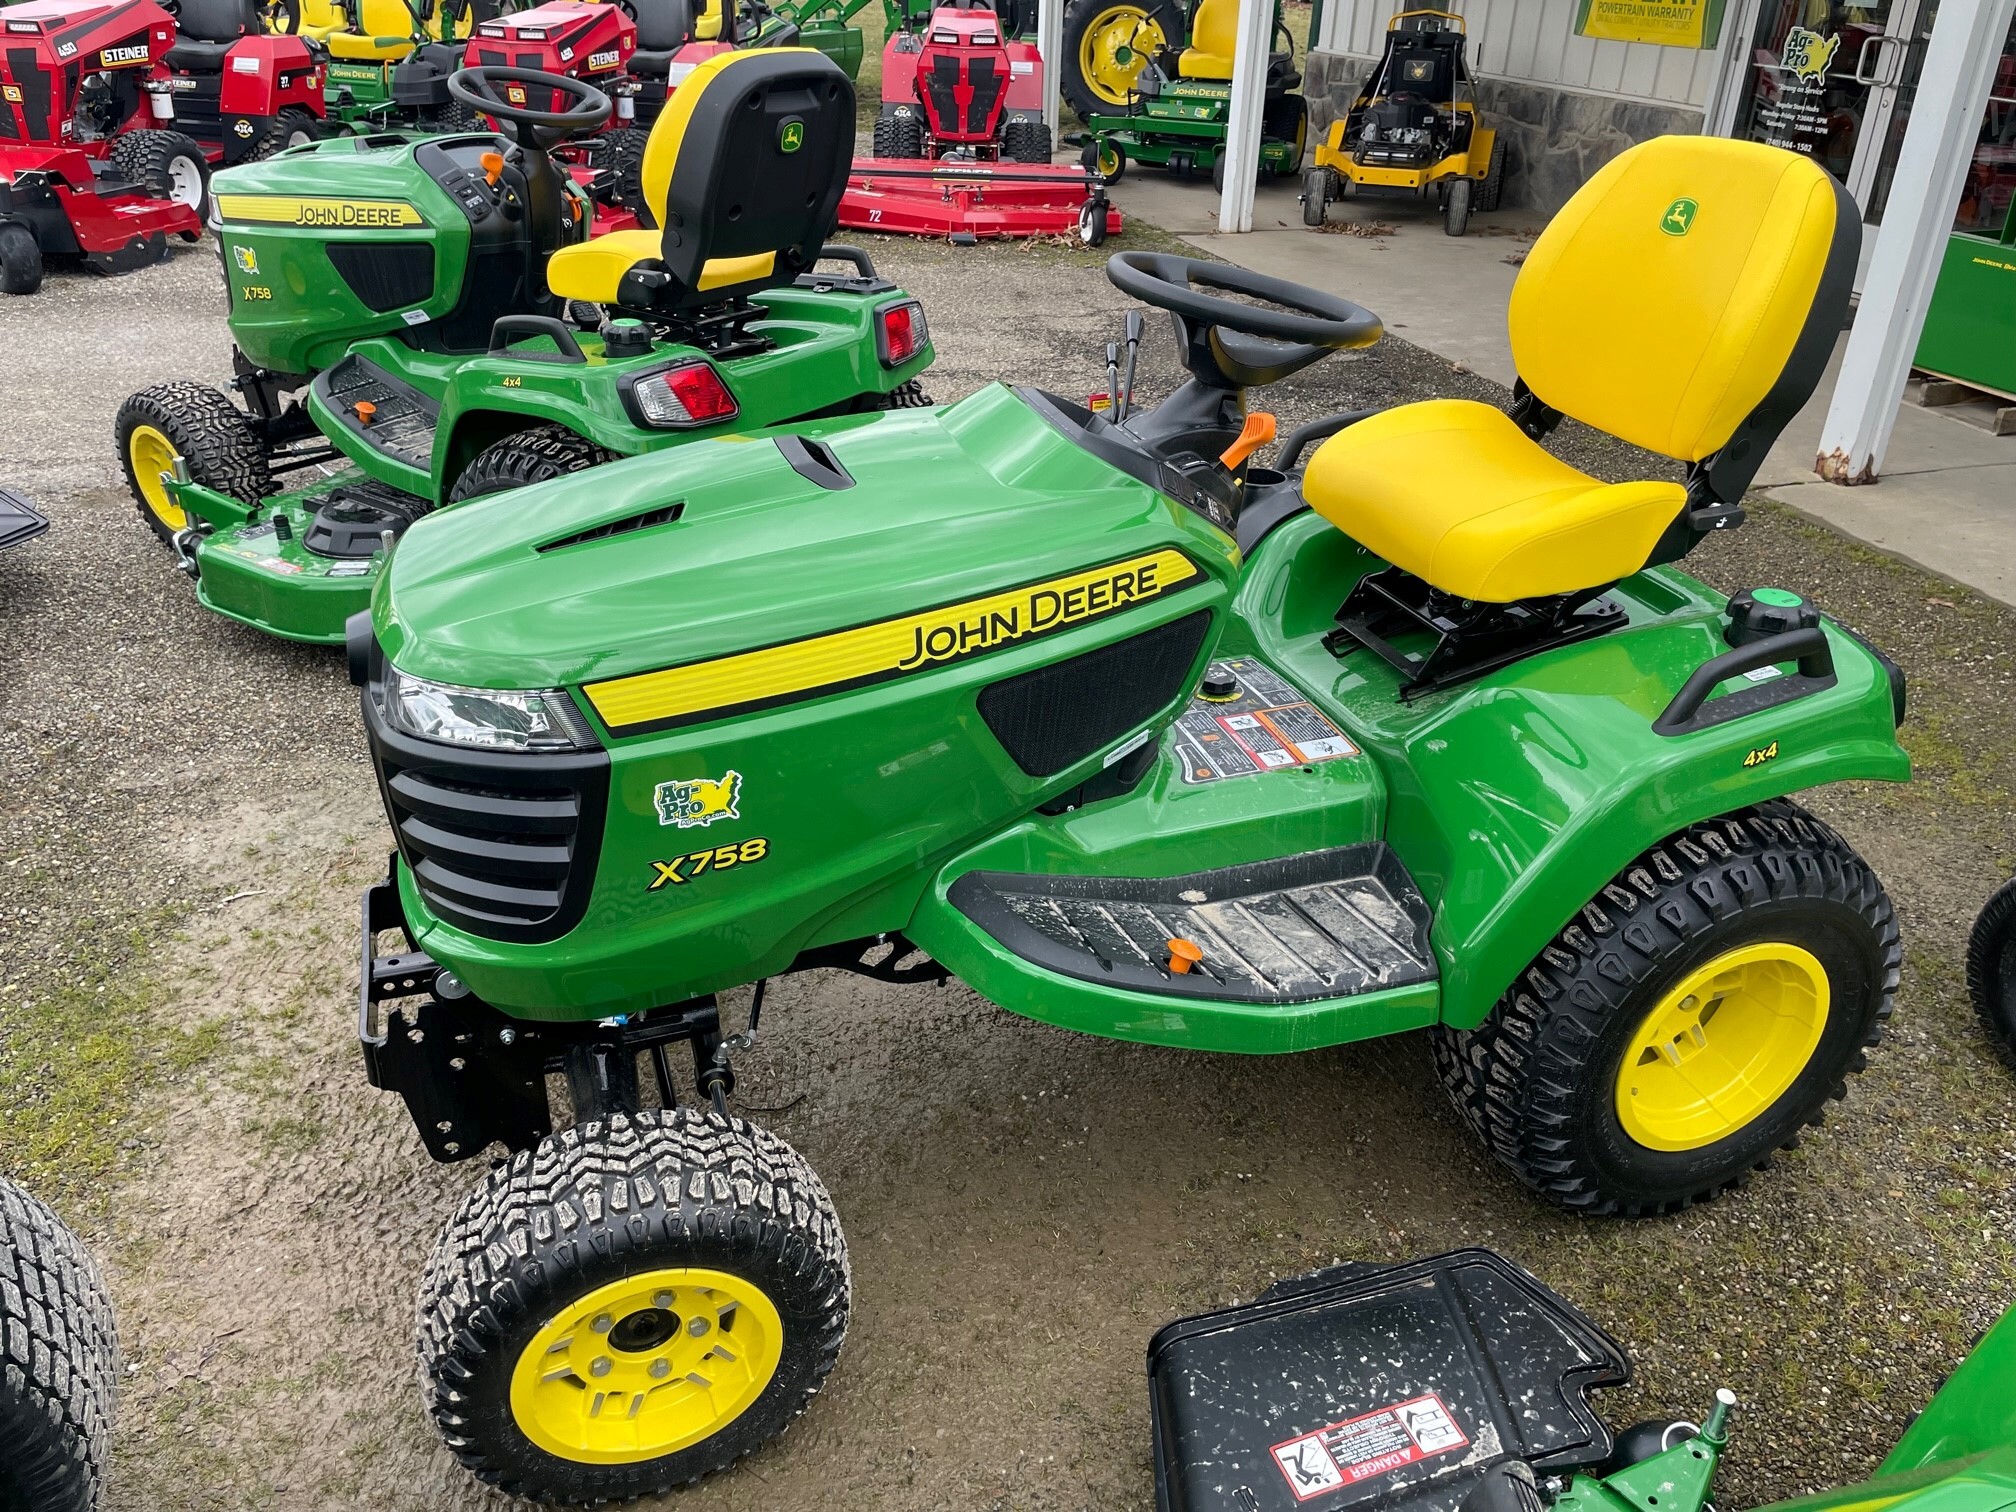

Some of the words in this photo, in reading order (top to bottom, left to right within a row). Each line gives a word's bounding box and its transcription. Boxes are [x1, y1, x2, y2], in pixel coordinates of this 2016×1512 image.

[1598, 3, 1645, 16] POWERTRAIN
[1647, 6, 1695, 20] WARRANTY
[1614, 16, 1638, 26] COMPACT
[1662, 19, 1692, 31] TRACTORS
[57, 42, 78, 57] 450
[104, 45, 149, 63] STEINER
[1783, 48, 1809, 67] Pro
[590, 50, 620, 67] STEINER
[332, 69, 351, 77] JOHN
[352, 70, 376, 79] DEERE
[172, 80, 197, 88] TEINER
[1172, 87, 1198, 96] JOHN
[1199, 88, 1228, 98] DEERE
[1766, 119, 1786, 129] Saturday
[1781, 140, 1793, 149] 944
[1797, 143, 1812, 152] 1502
[296, 204, 338, 224] JOHN
[342, 205, 401, 224] DEERE
[868, 209, 882, 222] 72
[242, 286, 272, 301] X758
[502, 376, 521, 388] 4x4
[899, 606, 1019, 667] JOHN
[1030, 562, 1159, 630] DEERE
[1743, 741, 1778, 767] 4x4
[659, 782, 700, 804] Ag-
[662, 800, 704, 821] Pro
[647, 837, 769, 890] X758
[1348, 1453, 1402, 1478] DANGER
